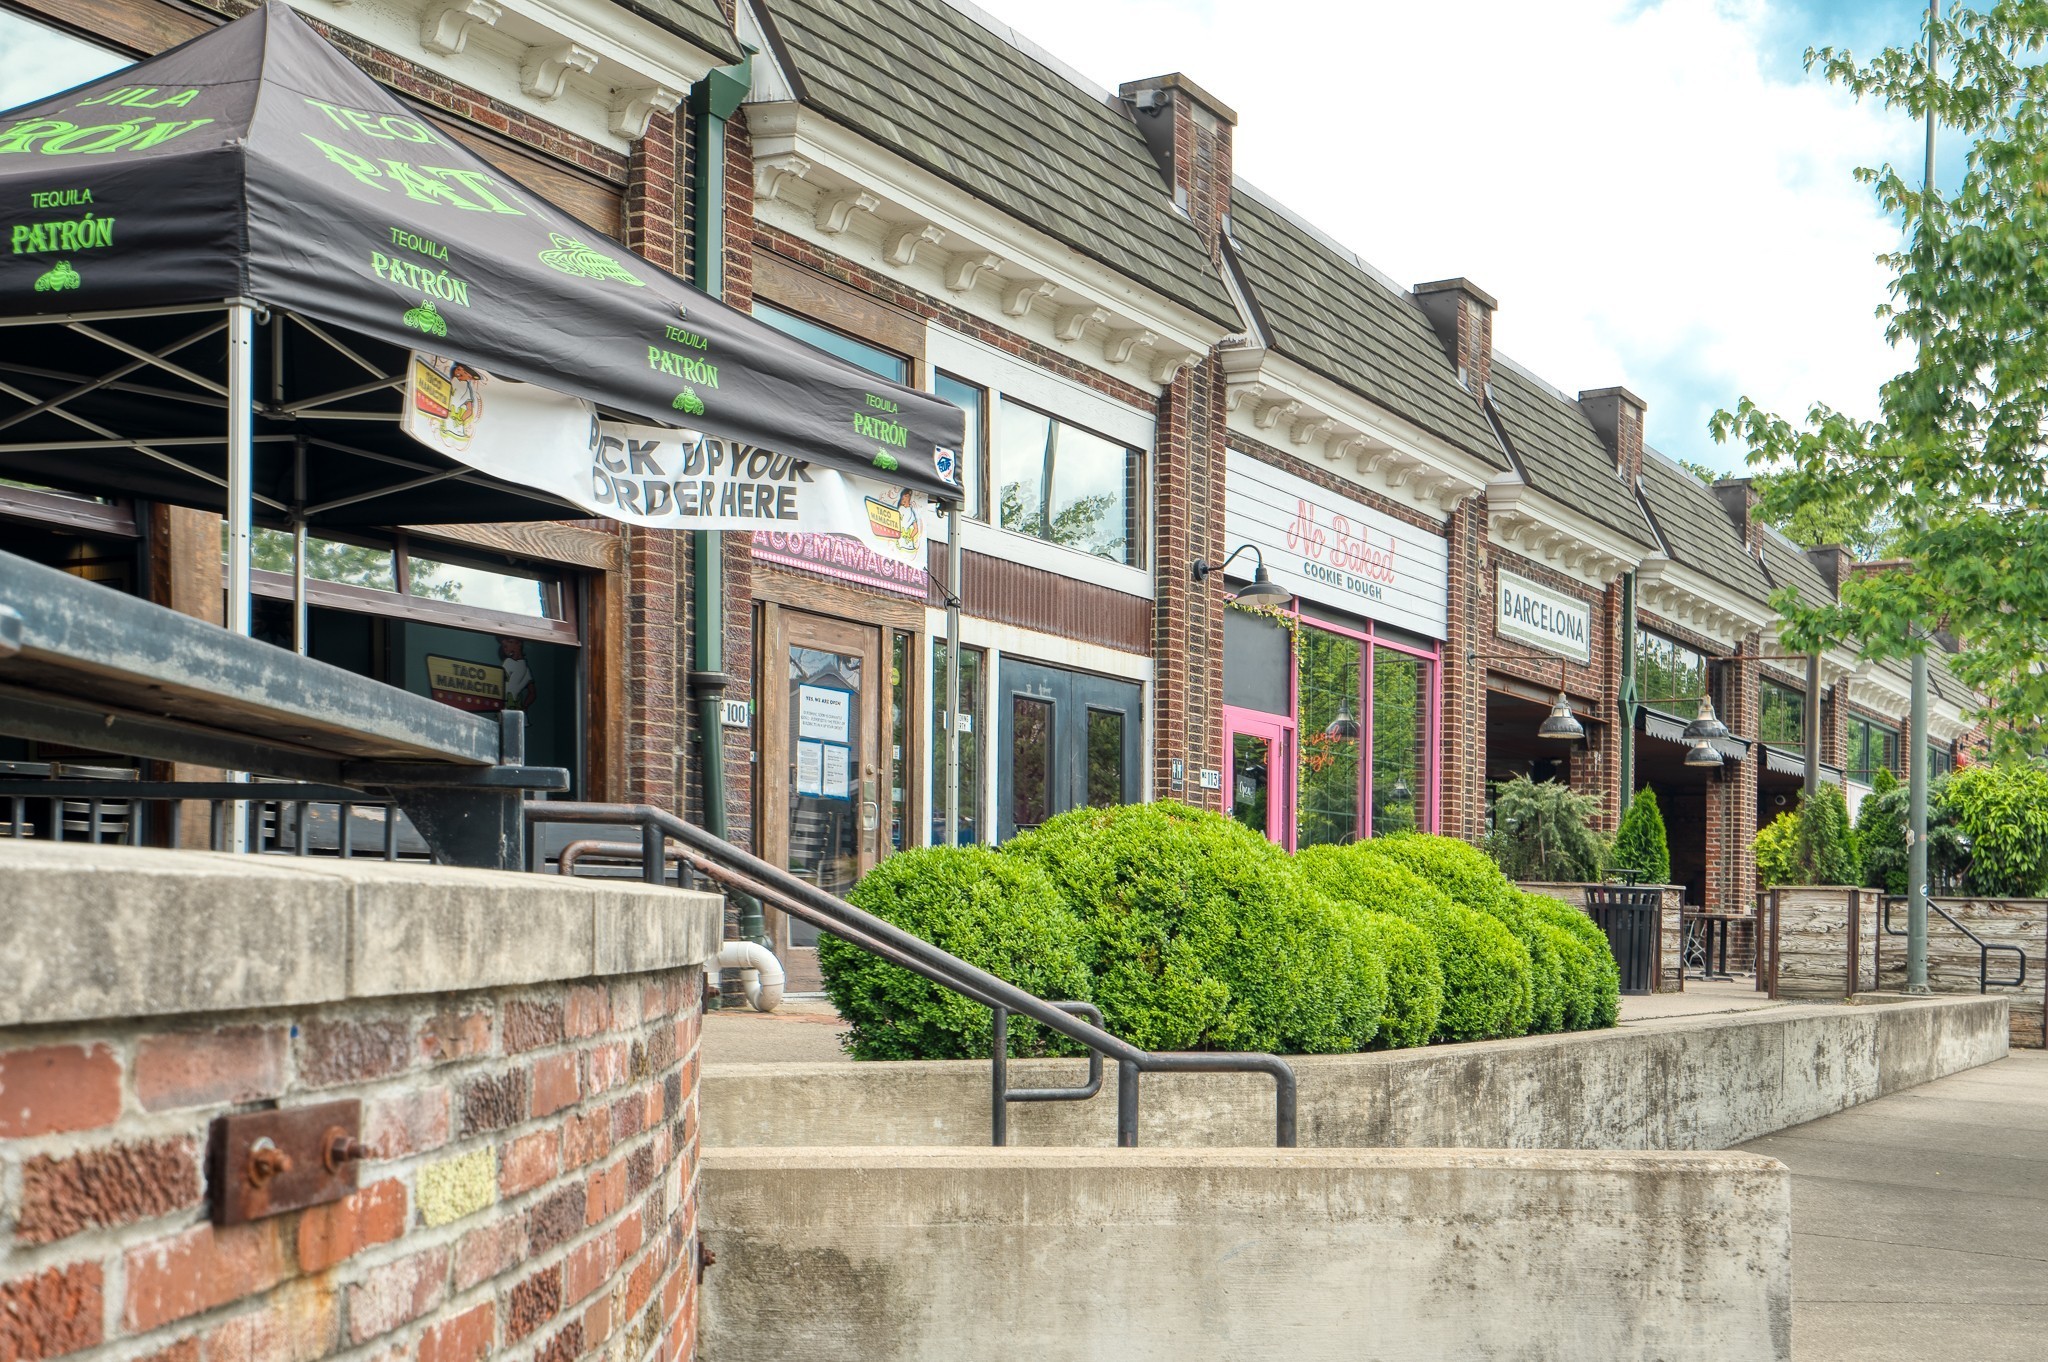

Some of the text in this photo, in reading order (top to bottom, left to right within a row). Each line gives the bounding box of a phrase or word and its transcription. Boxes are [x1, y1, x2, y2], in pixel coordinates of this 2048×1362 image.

[304, 98, 455, 151] TEQ
[301, 132, 535, 220] PAT
[31, 188, 94, 208] TEQUILA
[11, 213, 116, 254] PATRÓN
[390, 227, 448, 261] TEQUILA
[371, 251, 470, 307] PATRÓN
[666, 325, 708, 350] TEQUILA
[648, 345, 719, 389] PATRÓN
[865, 393, 898, 414] TEQUILA
[854, 412, 908, 448] PATRÓN
[683, 434, 724, 477] UP
[730, 442, 814, 483] YOUR
[593, 466, 798, 520] ORDER HERE
[871, 512, 899, 529] MAMACITA
[876, 506, 892, 519] TACO
[1287, 500, 1396, 584] No Baked
[1304, 561, 1382, 600] COOKIE DOUGH
[1504, 588, 1584, 643] BARCELONA
[436, 674, 500, 696] MAMACITA
[452, 663, 486, 681] TACO
[727, 702, 745, 723] 100
[1207, 772, 1218, 787] 113
